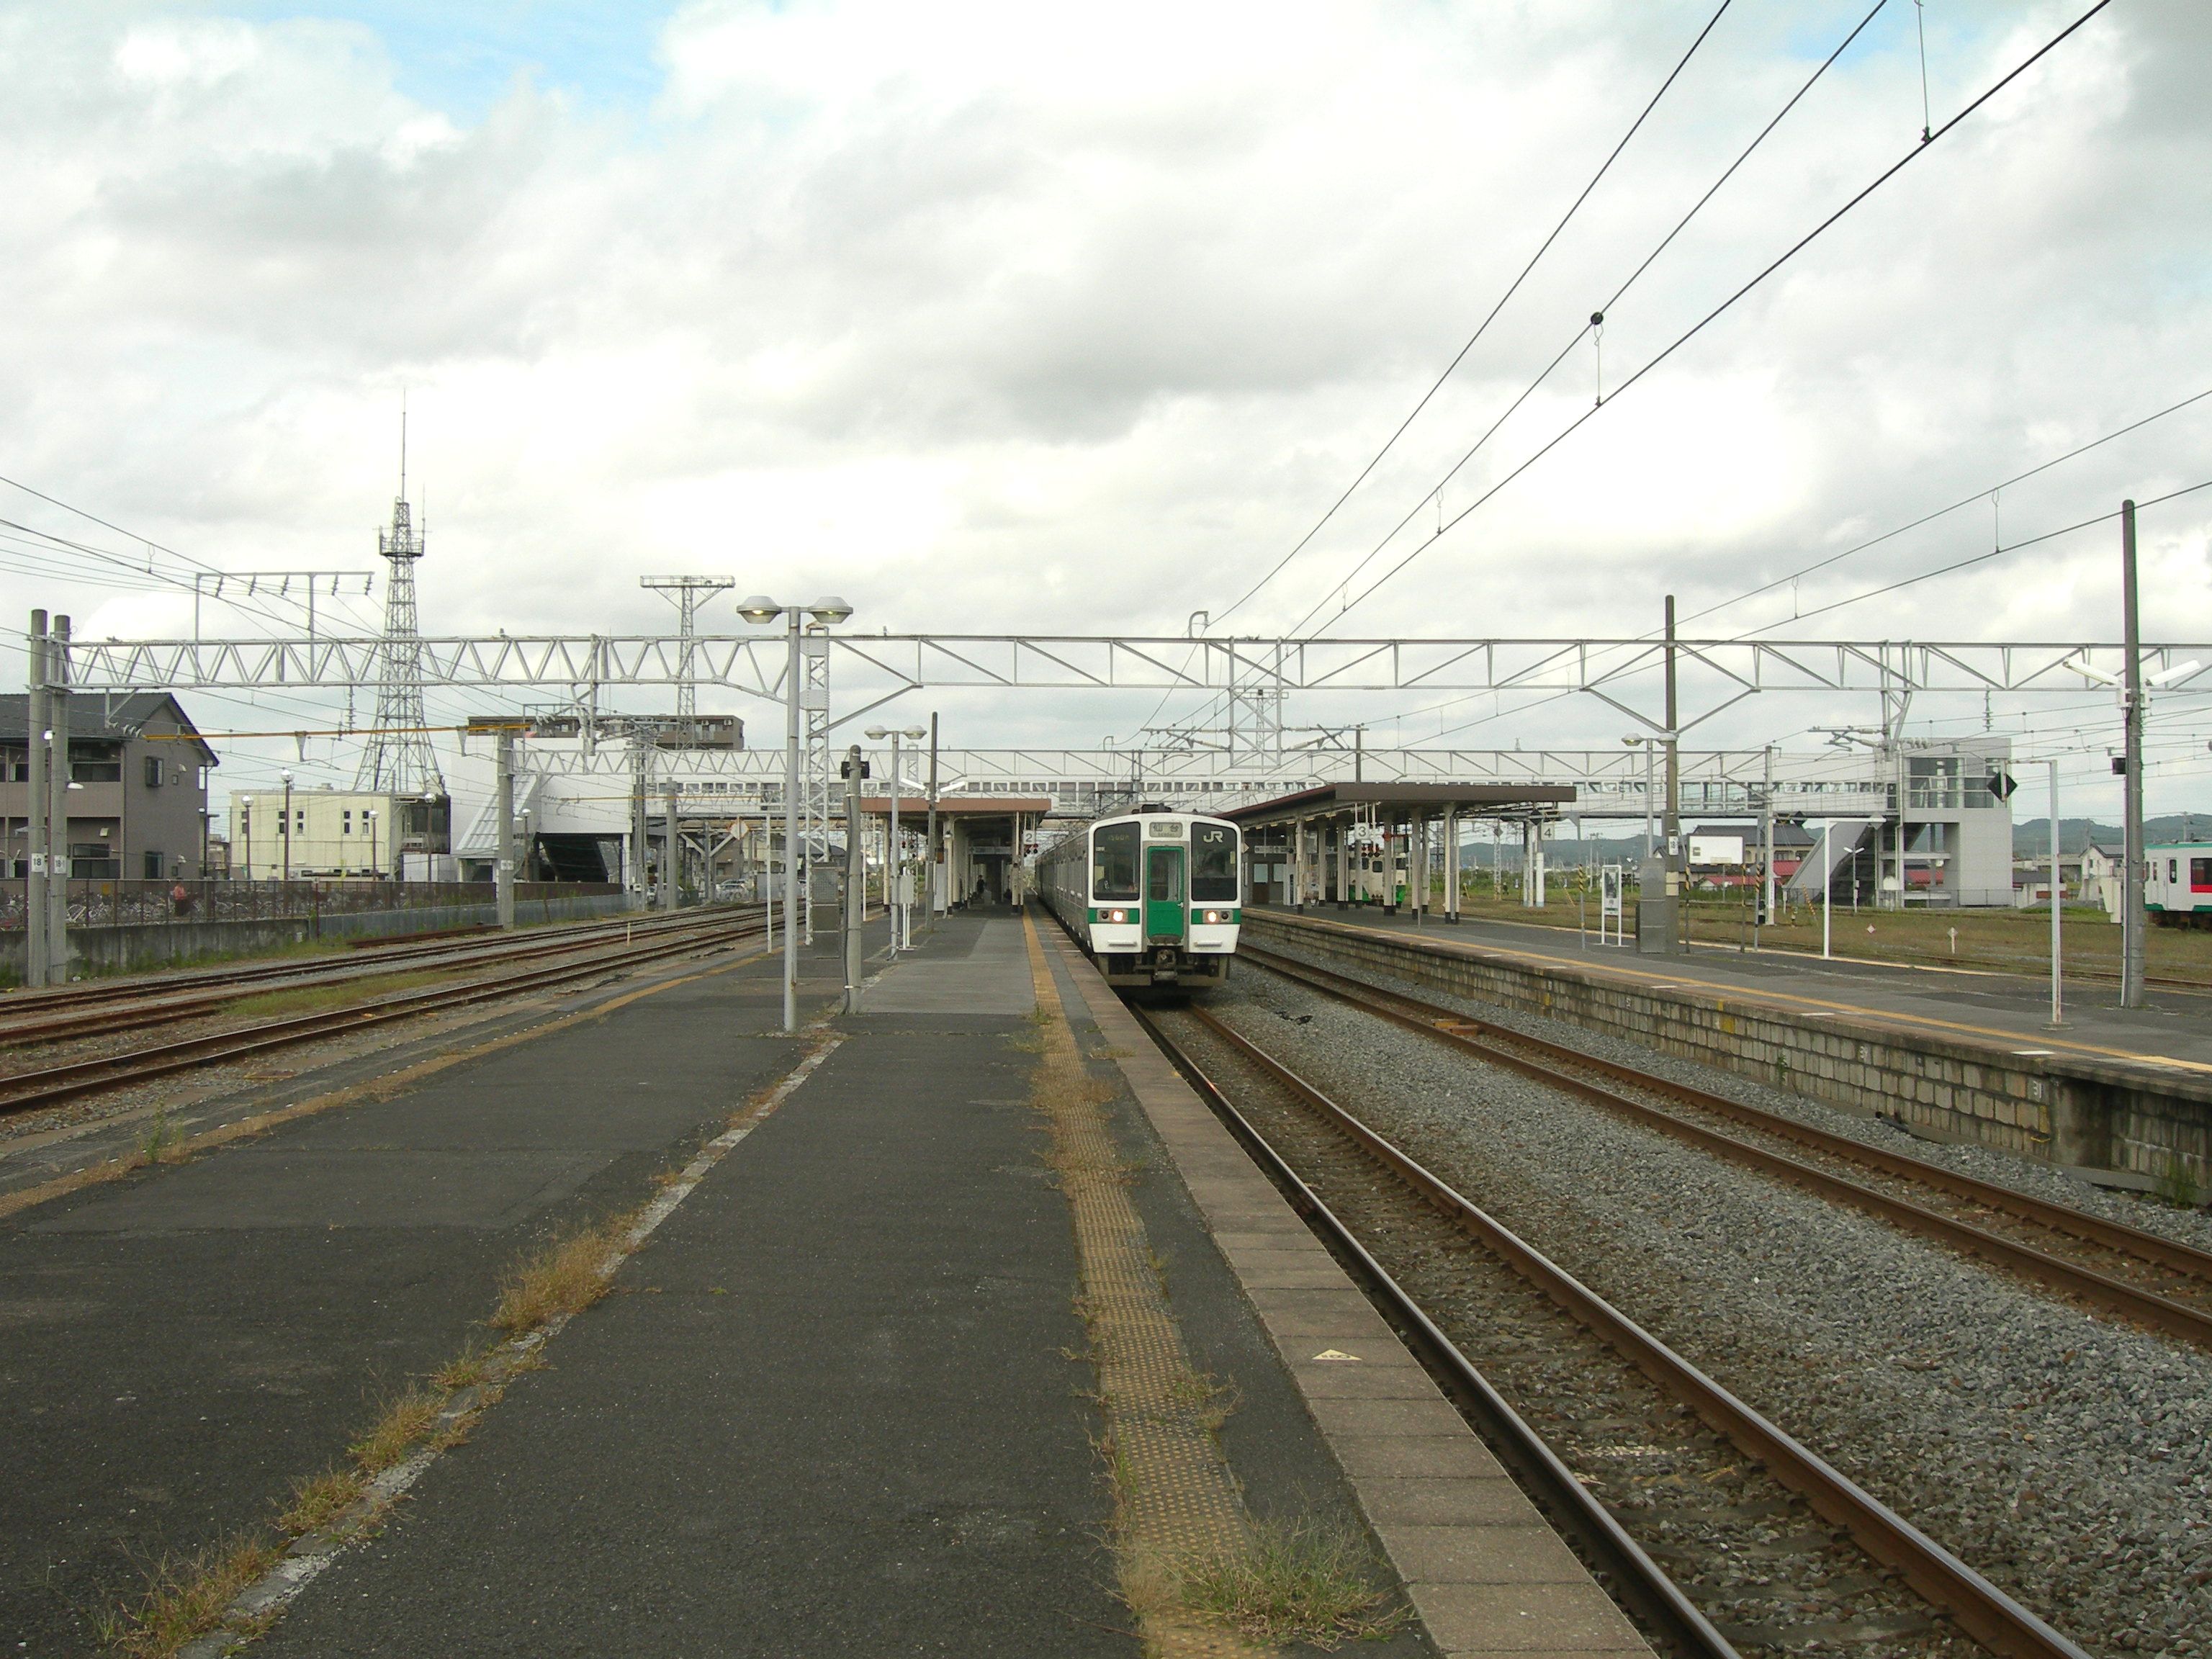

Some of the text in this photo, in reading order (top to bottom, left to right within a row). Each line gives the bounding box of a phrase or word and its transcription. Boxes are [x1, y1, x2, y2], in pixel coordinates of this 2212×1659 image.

[1025, 832, 1033, 842] 2
[1202, 830, 1223, 843] JR
[1358, 826, 1367, 837] 3
[1544, 827, 1552, 838] 4
[33, 858, 42, 866] 18
